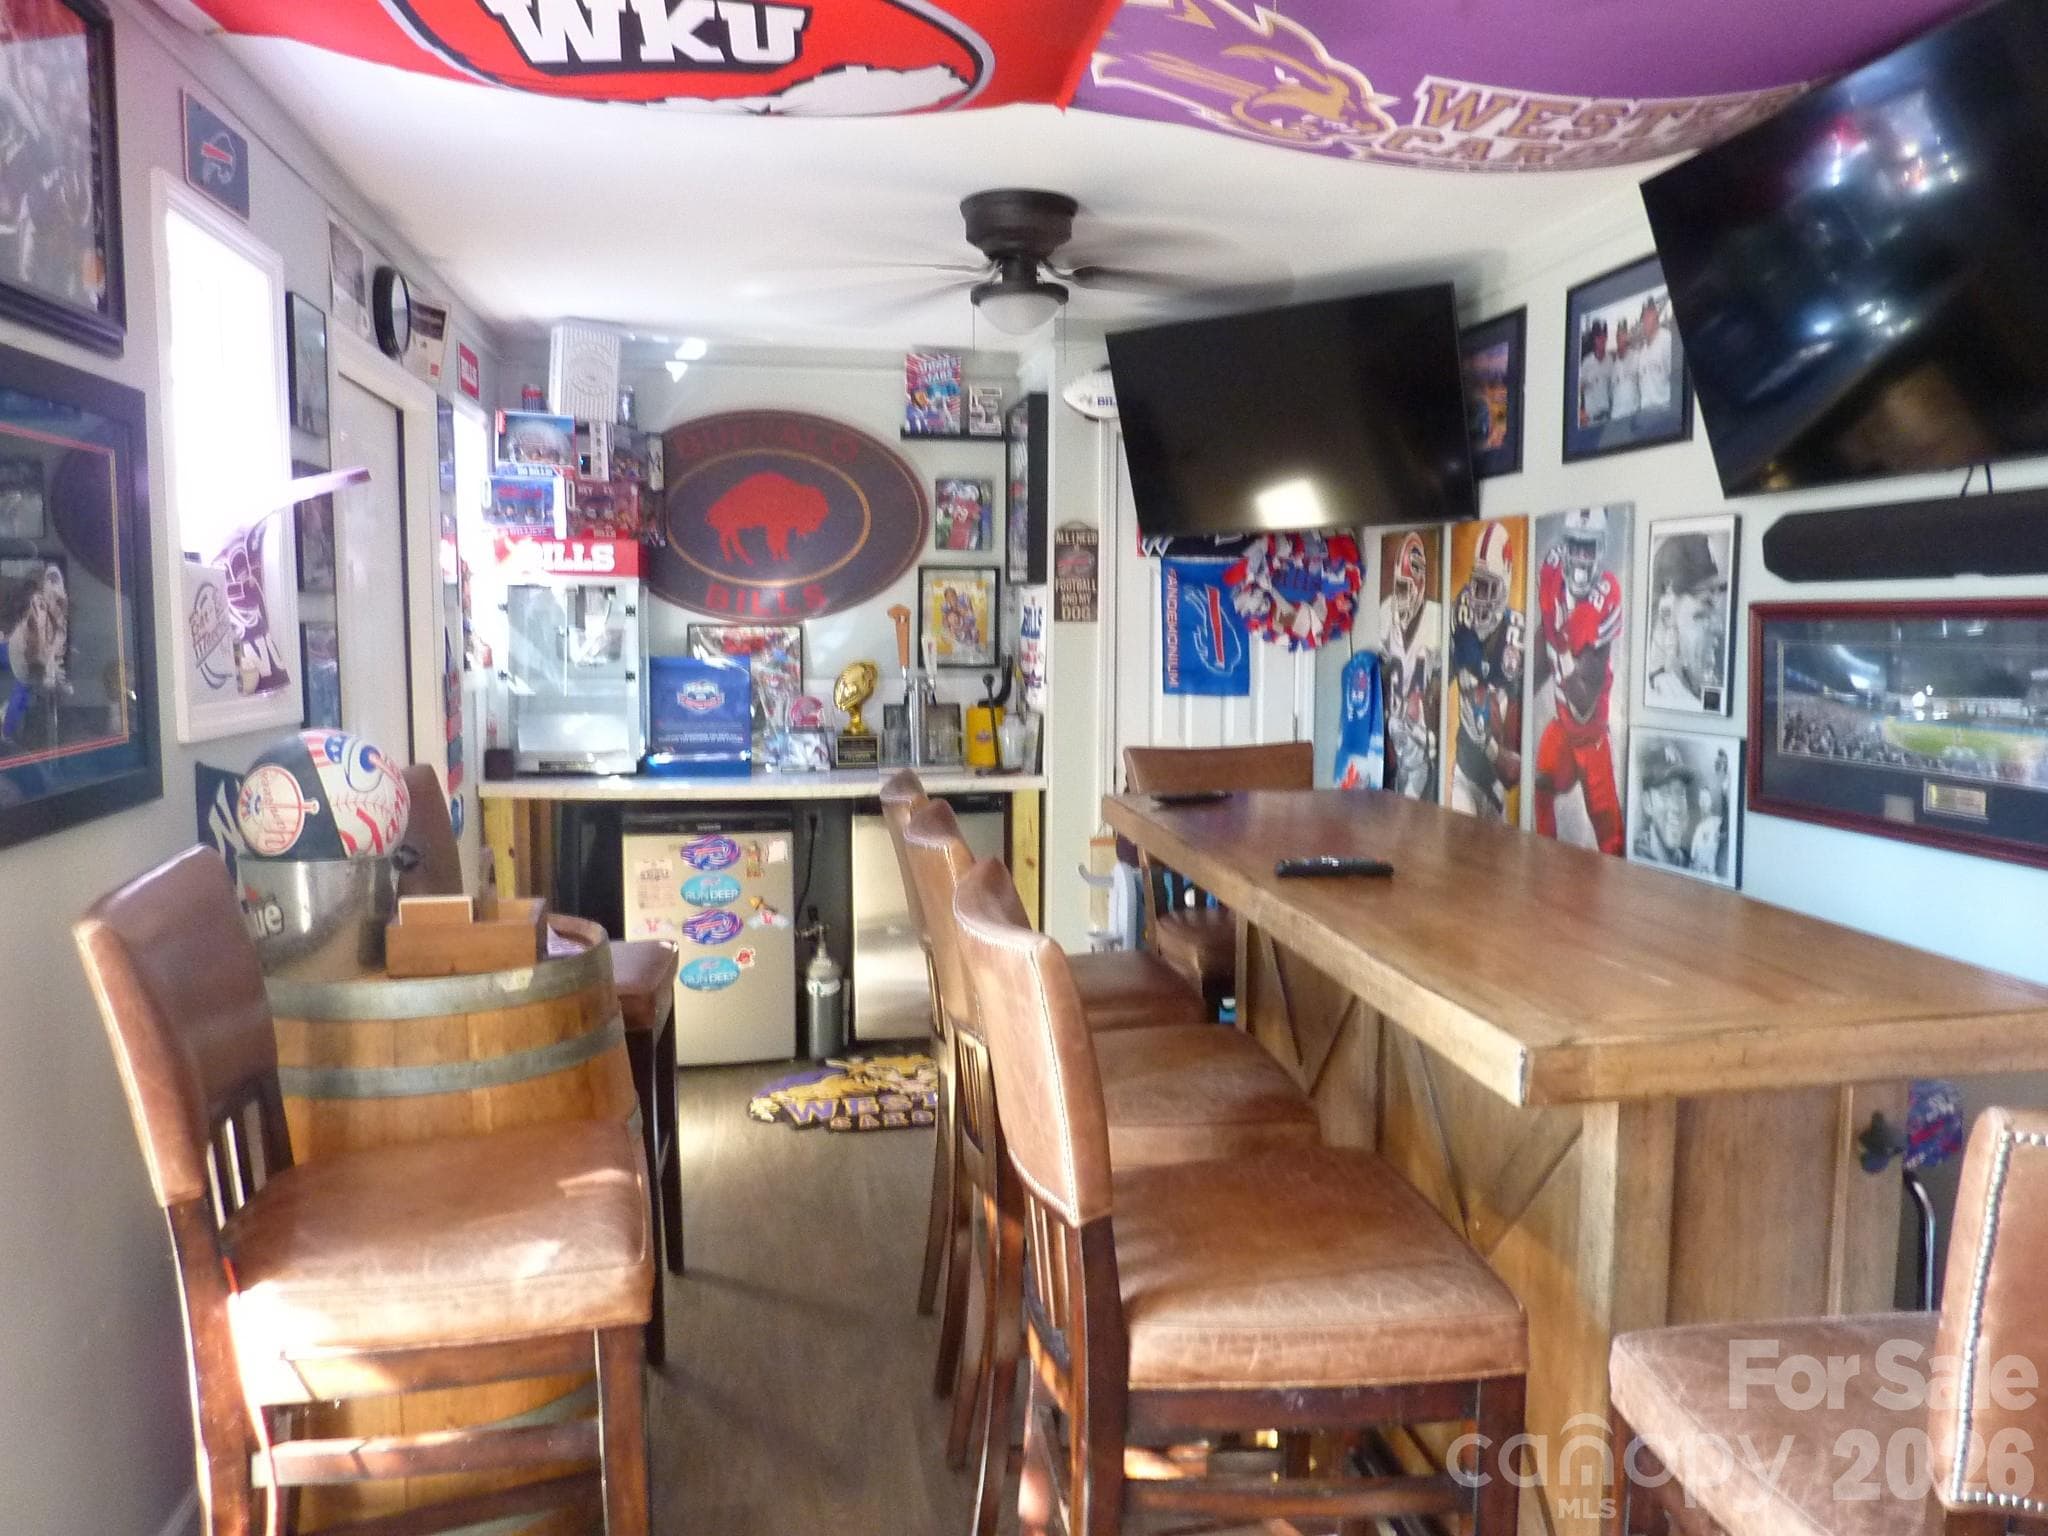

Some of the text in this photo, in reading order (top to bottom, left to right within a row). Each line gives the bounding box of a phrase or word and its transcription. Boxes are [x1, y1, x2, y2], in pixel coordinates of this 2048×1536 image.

[490, 0, 806, 63] WKU
[518, 539, 616, 572] ILLS
[705, 583, 828, 616] BILLS
[709, 888, 739, 900] DEEP
